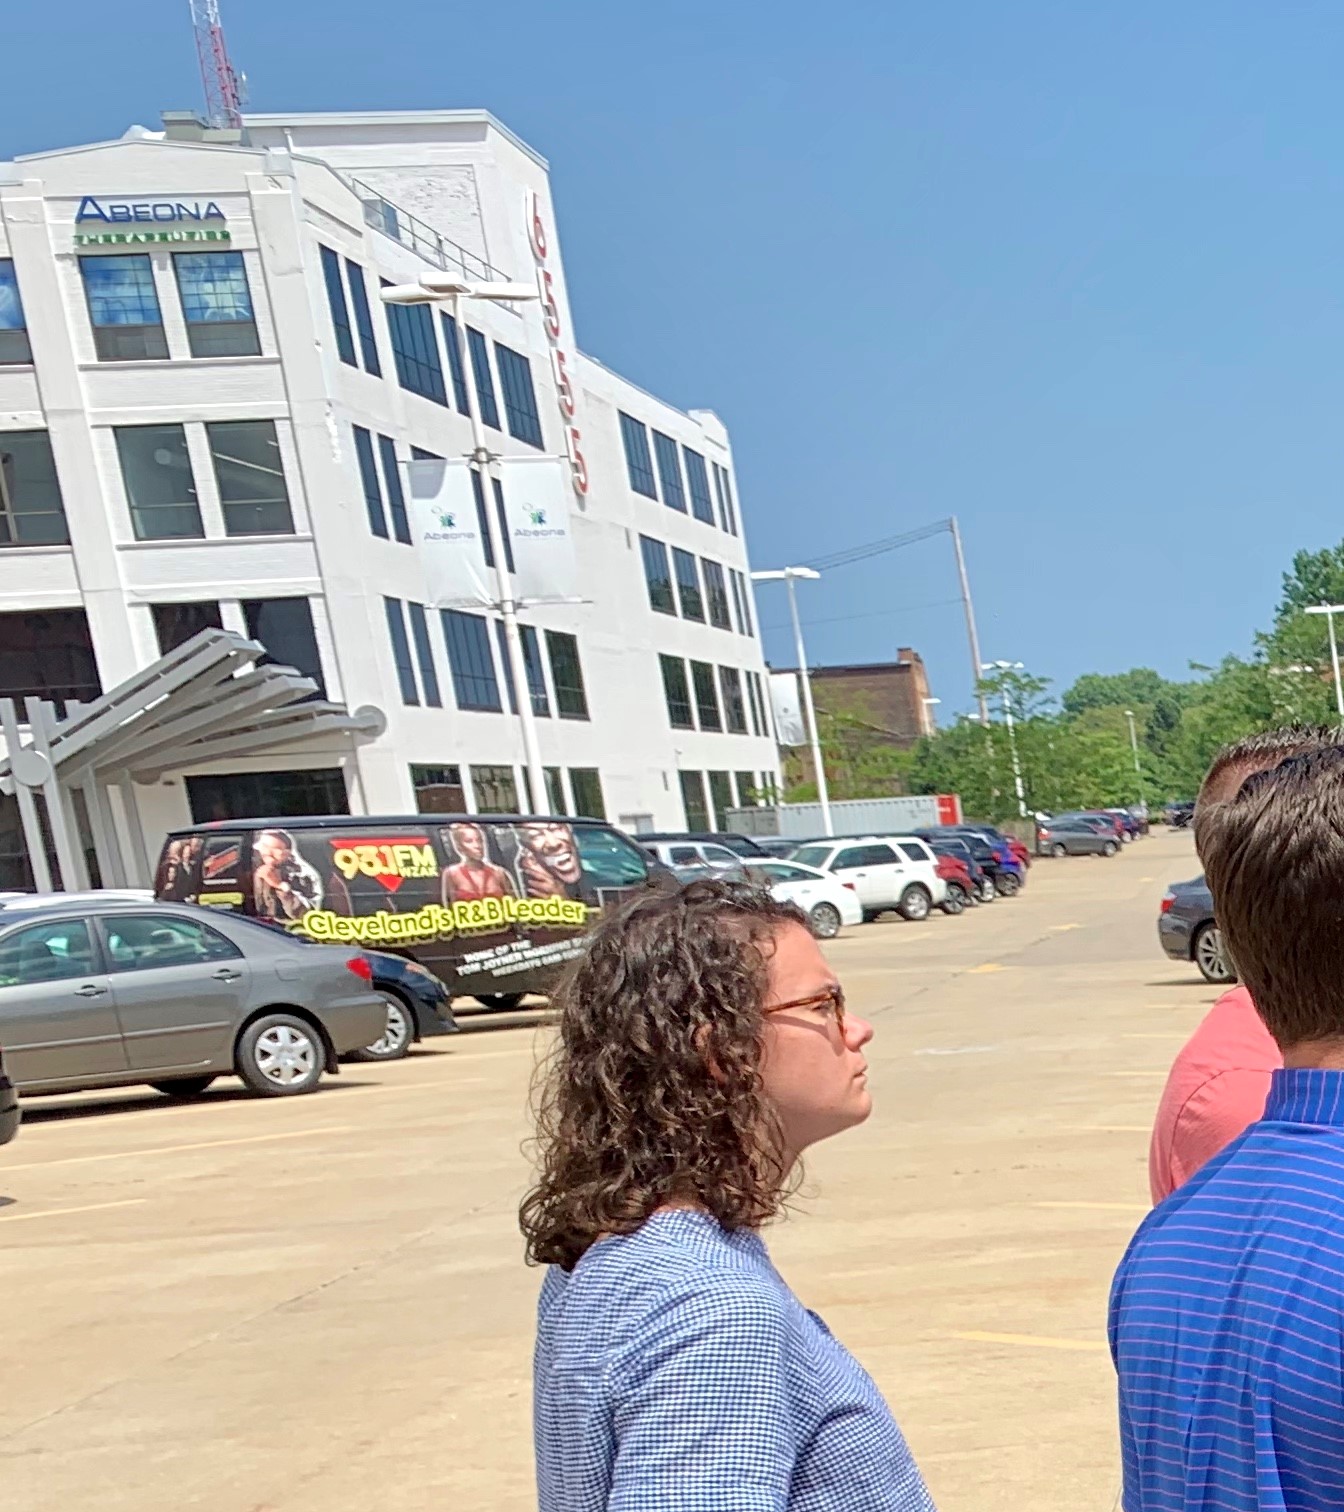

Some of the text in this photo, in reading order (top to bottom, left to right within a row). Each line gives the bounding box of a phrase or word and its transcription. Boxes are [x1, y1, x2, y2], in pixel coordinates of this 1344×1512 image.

[75, 195, 226, 224] ABEONA
[397, 845, 436, 869] FM
[307, 897, 584, 936] Cleveland's R&B Leader
[482, 952, 523, 970] JOYNER
